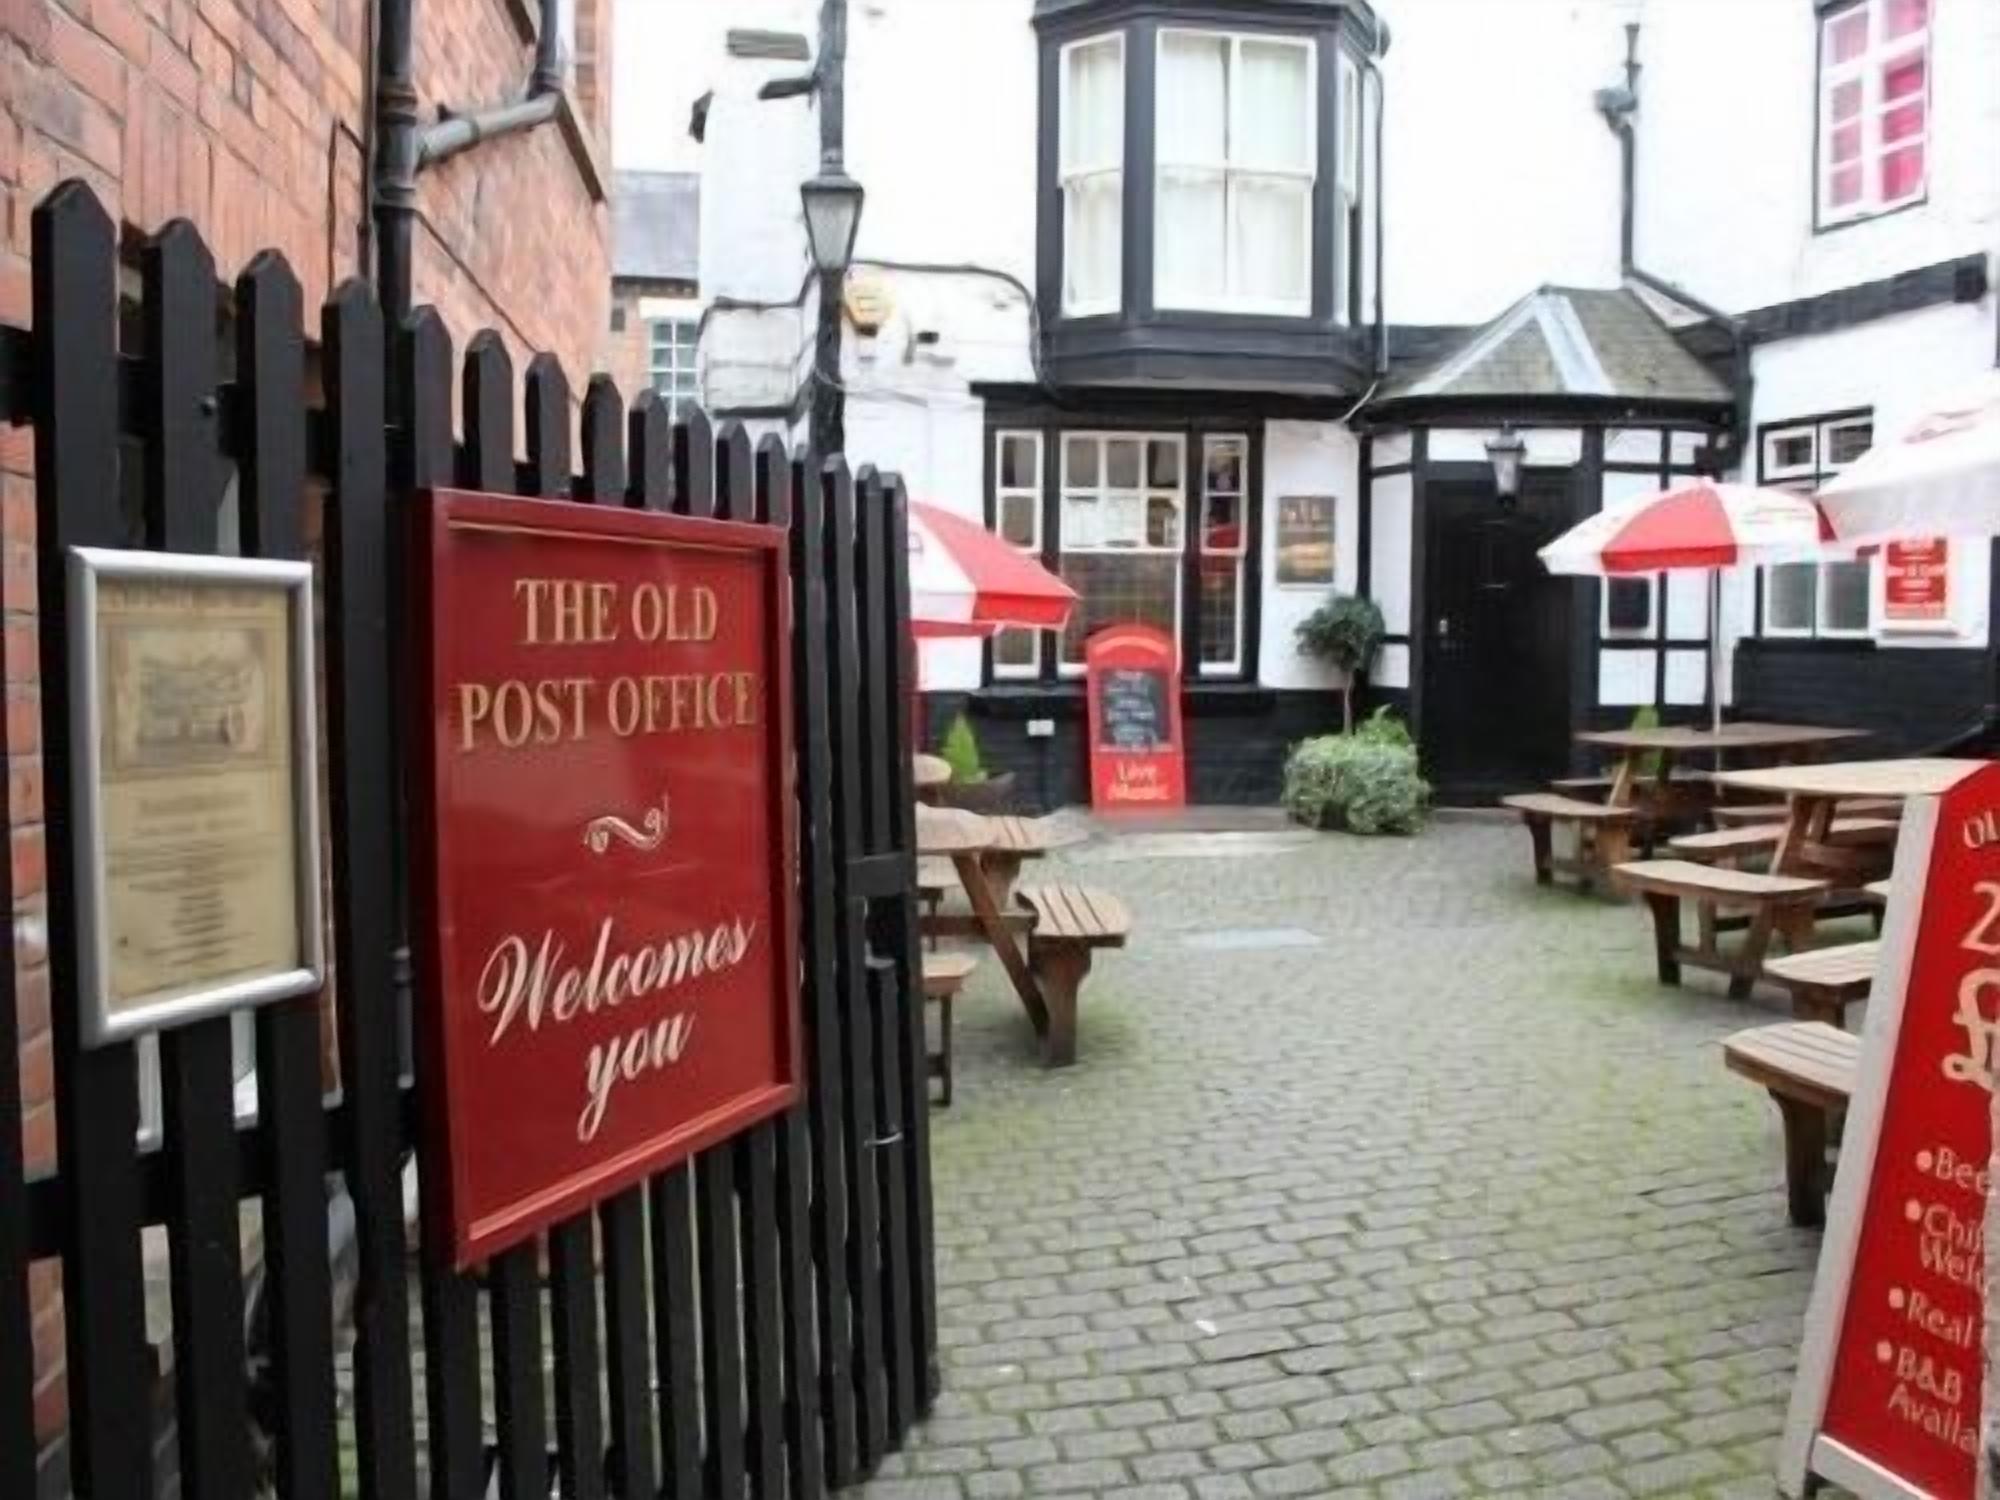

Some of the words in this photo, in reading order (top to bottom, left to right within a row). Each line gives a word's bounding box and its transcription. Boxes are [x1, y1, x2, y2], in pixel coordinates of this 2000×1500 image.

[514, 578, 620, 644] THE
[631, 582, 719, 642] OLD
[454, 679, 596, 752] POST
[608, 670, 759, 737] OFFICE
[476, 915, 757, 1047] Welcomes
[577, 1010, 698, 1144] you
[1908, 1291, 1974, 1349] Real
[1897, 1347, 1962, 1405] B&B
